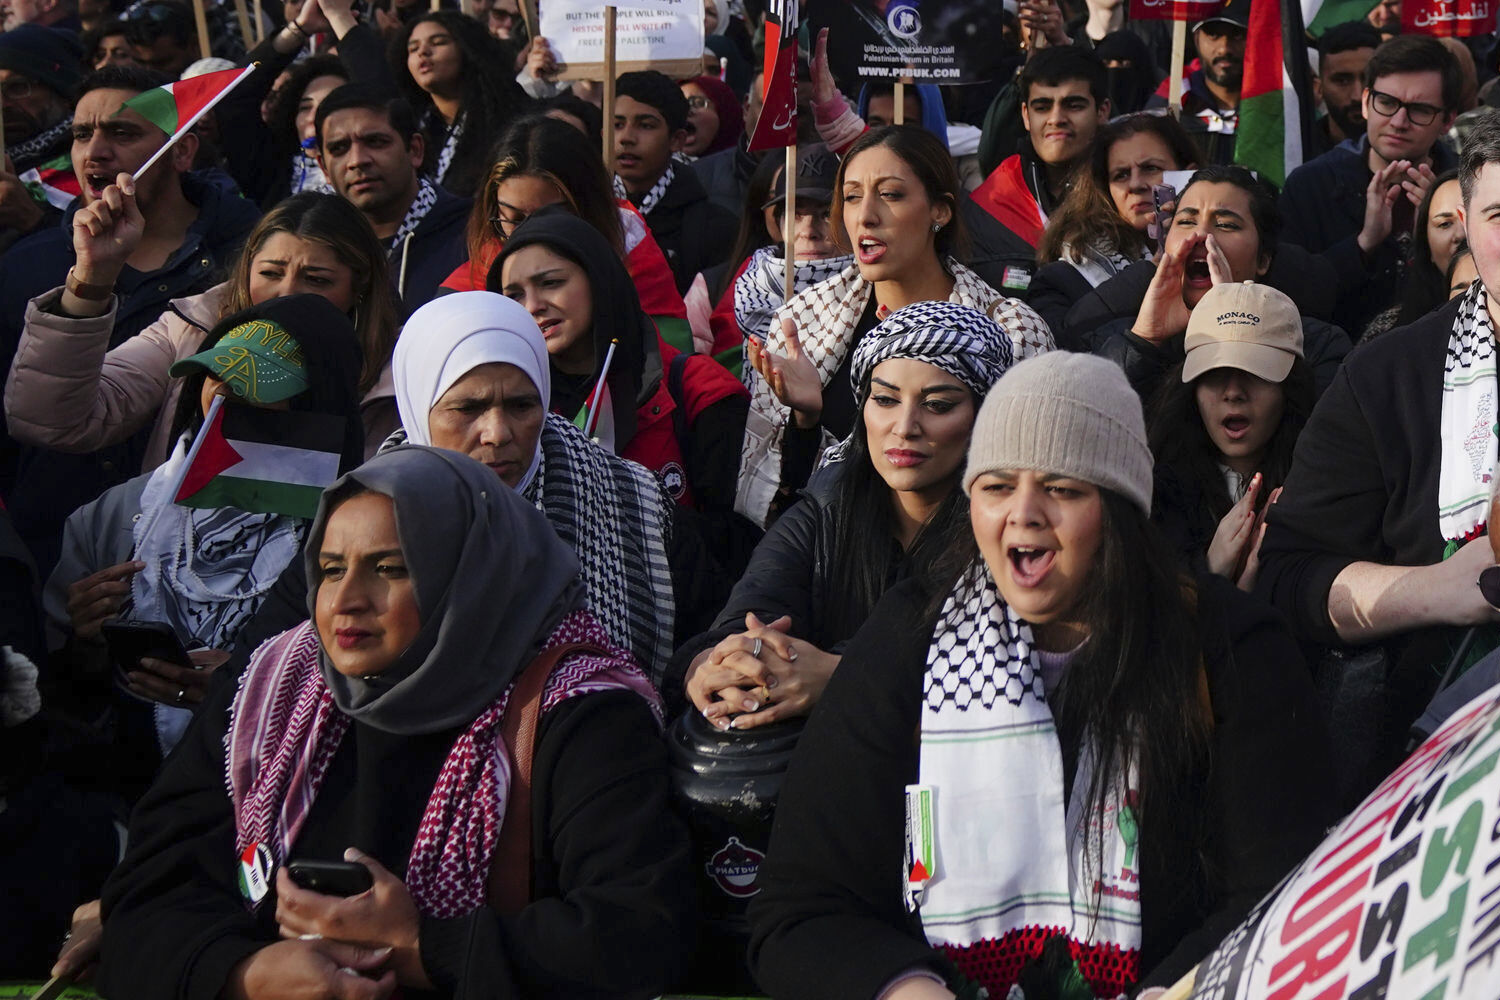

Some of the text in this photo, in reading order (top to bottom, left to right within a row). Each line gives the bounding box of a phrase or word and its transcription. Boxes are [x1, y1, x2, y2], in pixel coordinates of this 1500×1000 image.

[1414, 2, 1489, 27] لفلسطين
[572, 24, 604, 33] HISTOR
[621, 36, 665, 46] PALESTINE
[863, 54, 955, 64] Palestinian Forum in Britain
[858, 66, 960, 78] WWW.PFBUK.COM
[1216, 311, 1260, 323] MONACO
